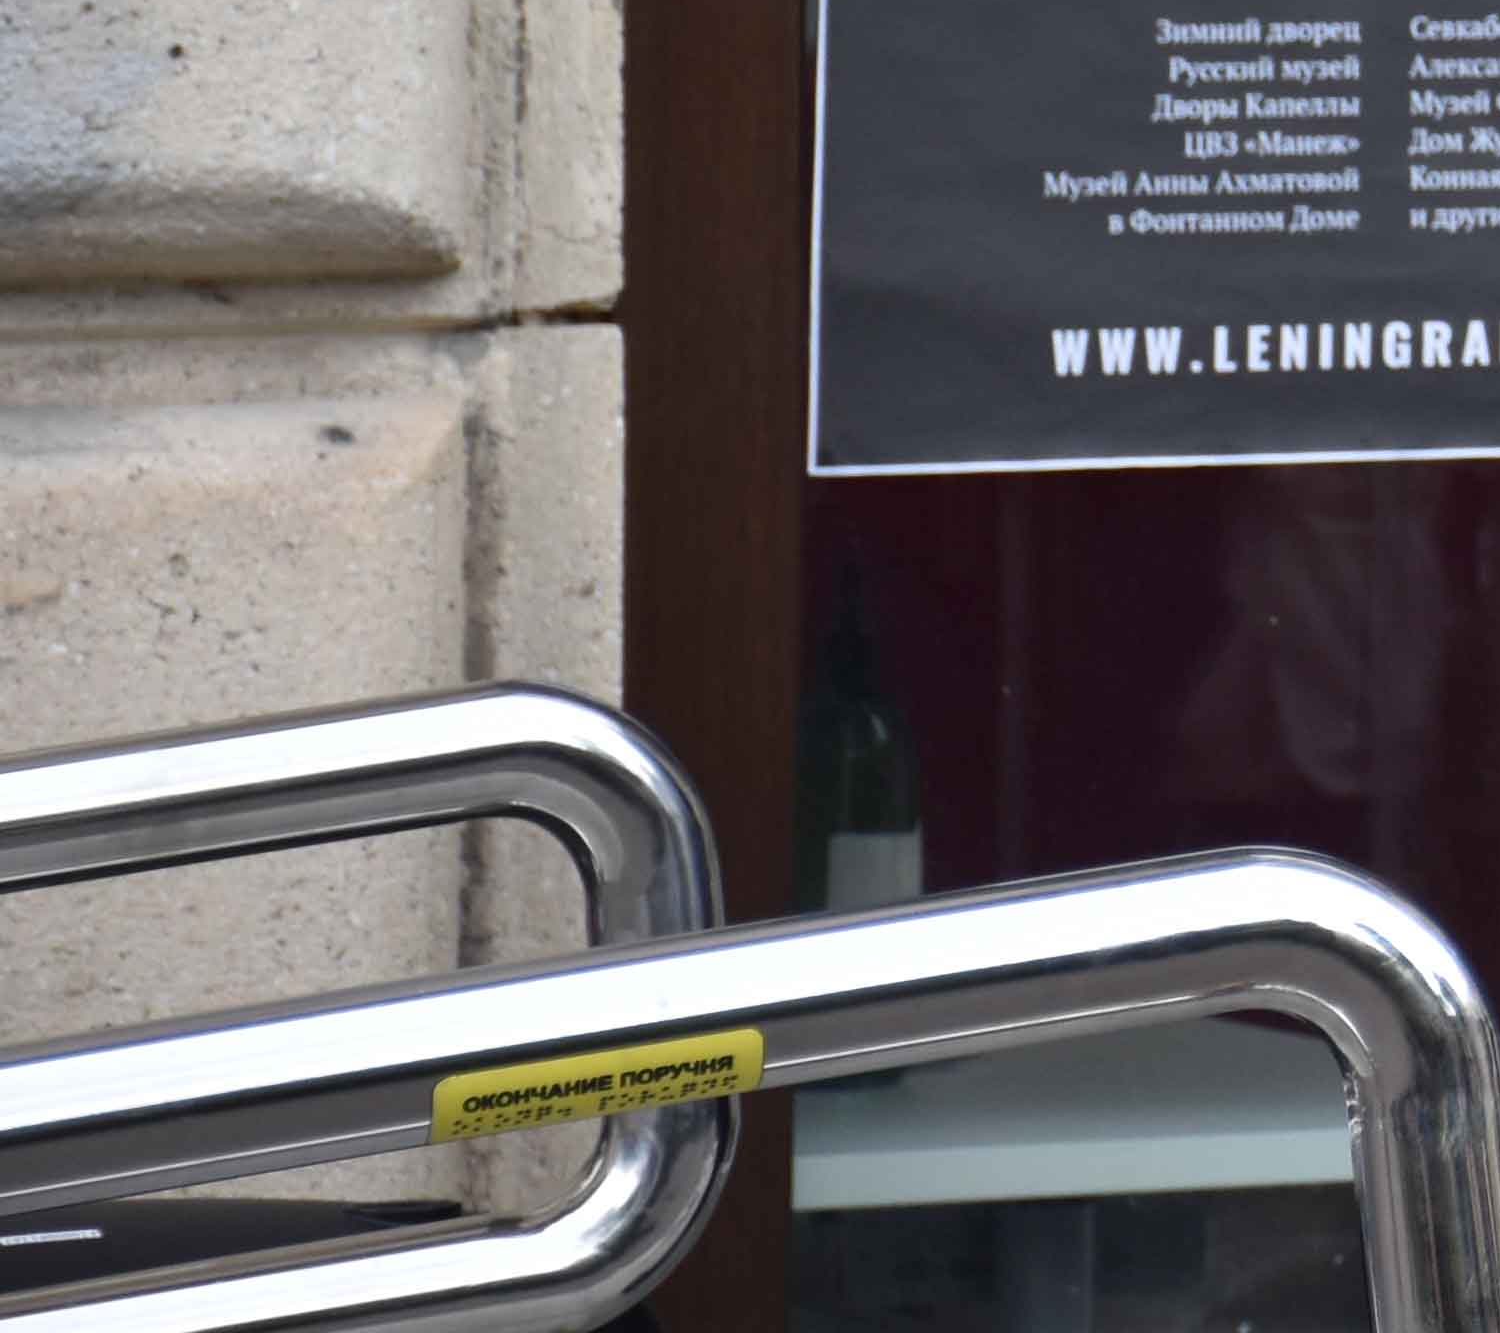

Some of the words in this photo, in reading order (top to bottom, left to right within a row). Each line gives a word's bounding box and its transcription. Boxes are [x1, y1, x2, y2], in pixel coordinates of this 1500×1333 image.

[1156, 17, 1262, 45] Зимний
[1265, 20, 1362, 48] дворец
[1168, 56, 1274, 87] Русский
[1282, 54, 1361, 83] музей
[1151, 93, 1238, 125] Дворы
[1245, 92, 1361, 118] Капеллы
[1407, 88, 1492, 121] Музей
[1184, 131, 1238, 160] ЦВЗ
[1245, 131, 1361, 155] «Манеж»
[1407, 127, 1463, 156] Дом
[1043, 170, 1128, 203] Музей
[1133, 171, 1209, 196] Анны
[1215, 167, 1360, 194] Ахматовой
[1108, 214, 1125, 235] в
[1129, 208, 1285, 234] Фонтанном
[1288, 204, 1361, 233] Доме
[1409, 208, 1428, 229] и
[462, 1072, 614, 1115] ОКОНЧАНИЕ
[618, 1053, 735, 1090] ПОРУЧНЯ
